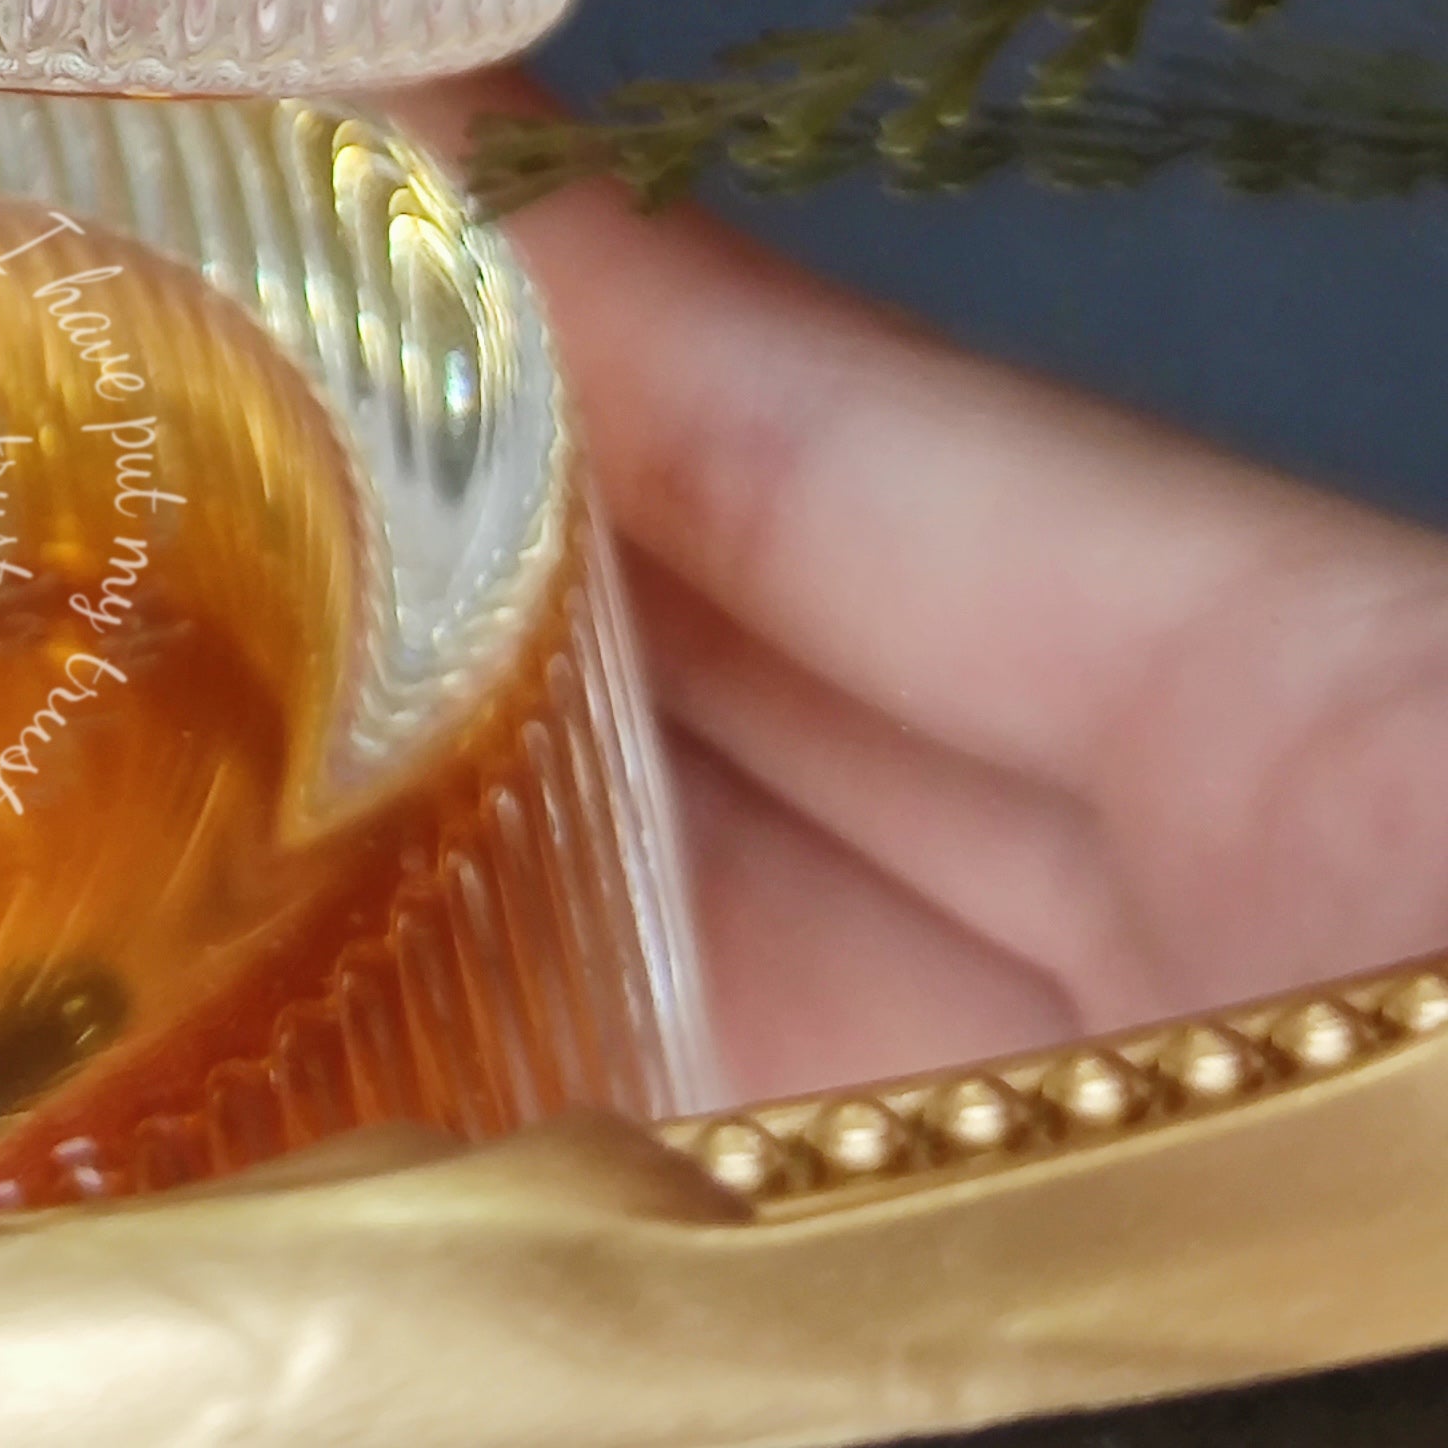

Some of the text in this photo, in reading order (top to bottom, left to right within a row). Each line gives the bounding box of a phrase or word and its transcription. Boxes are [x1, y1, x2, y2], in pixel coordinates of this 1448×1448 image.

[32, 264, 146, 403] have
[80, 415, 189, 518] put
[67, 536, 150, 634] my
